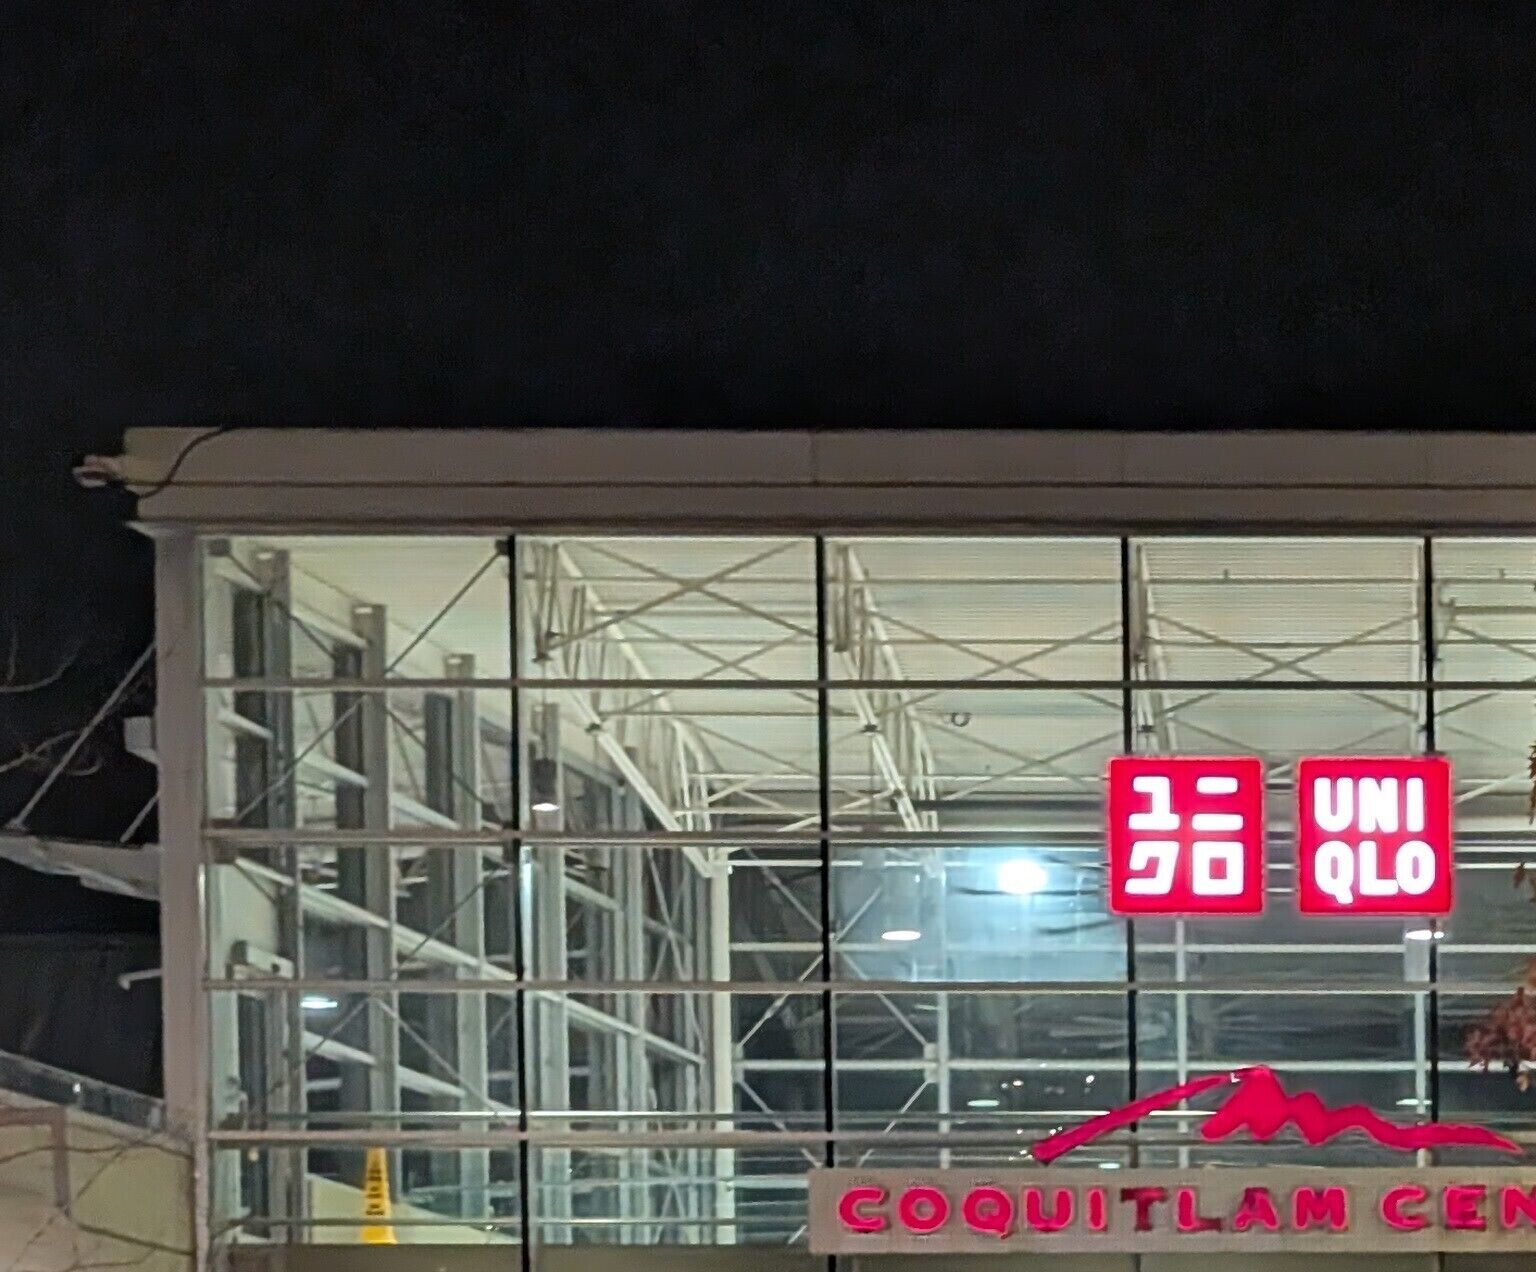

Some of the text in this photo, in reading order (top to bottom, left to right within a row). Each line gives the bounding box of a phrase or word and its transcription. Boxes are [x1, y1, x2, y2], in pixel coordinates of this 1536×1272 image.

[1127, 775, 1244, 832] ユニ
[1313, 776, 1425, 833] UNI
[1124, 839, 1244, 896] クロ
[1313, 839, 1436, 904] QLO
[837, 1184, 1348, 1238] COQUITLAM
